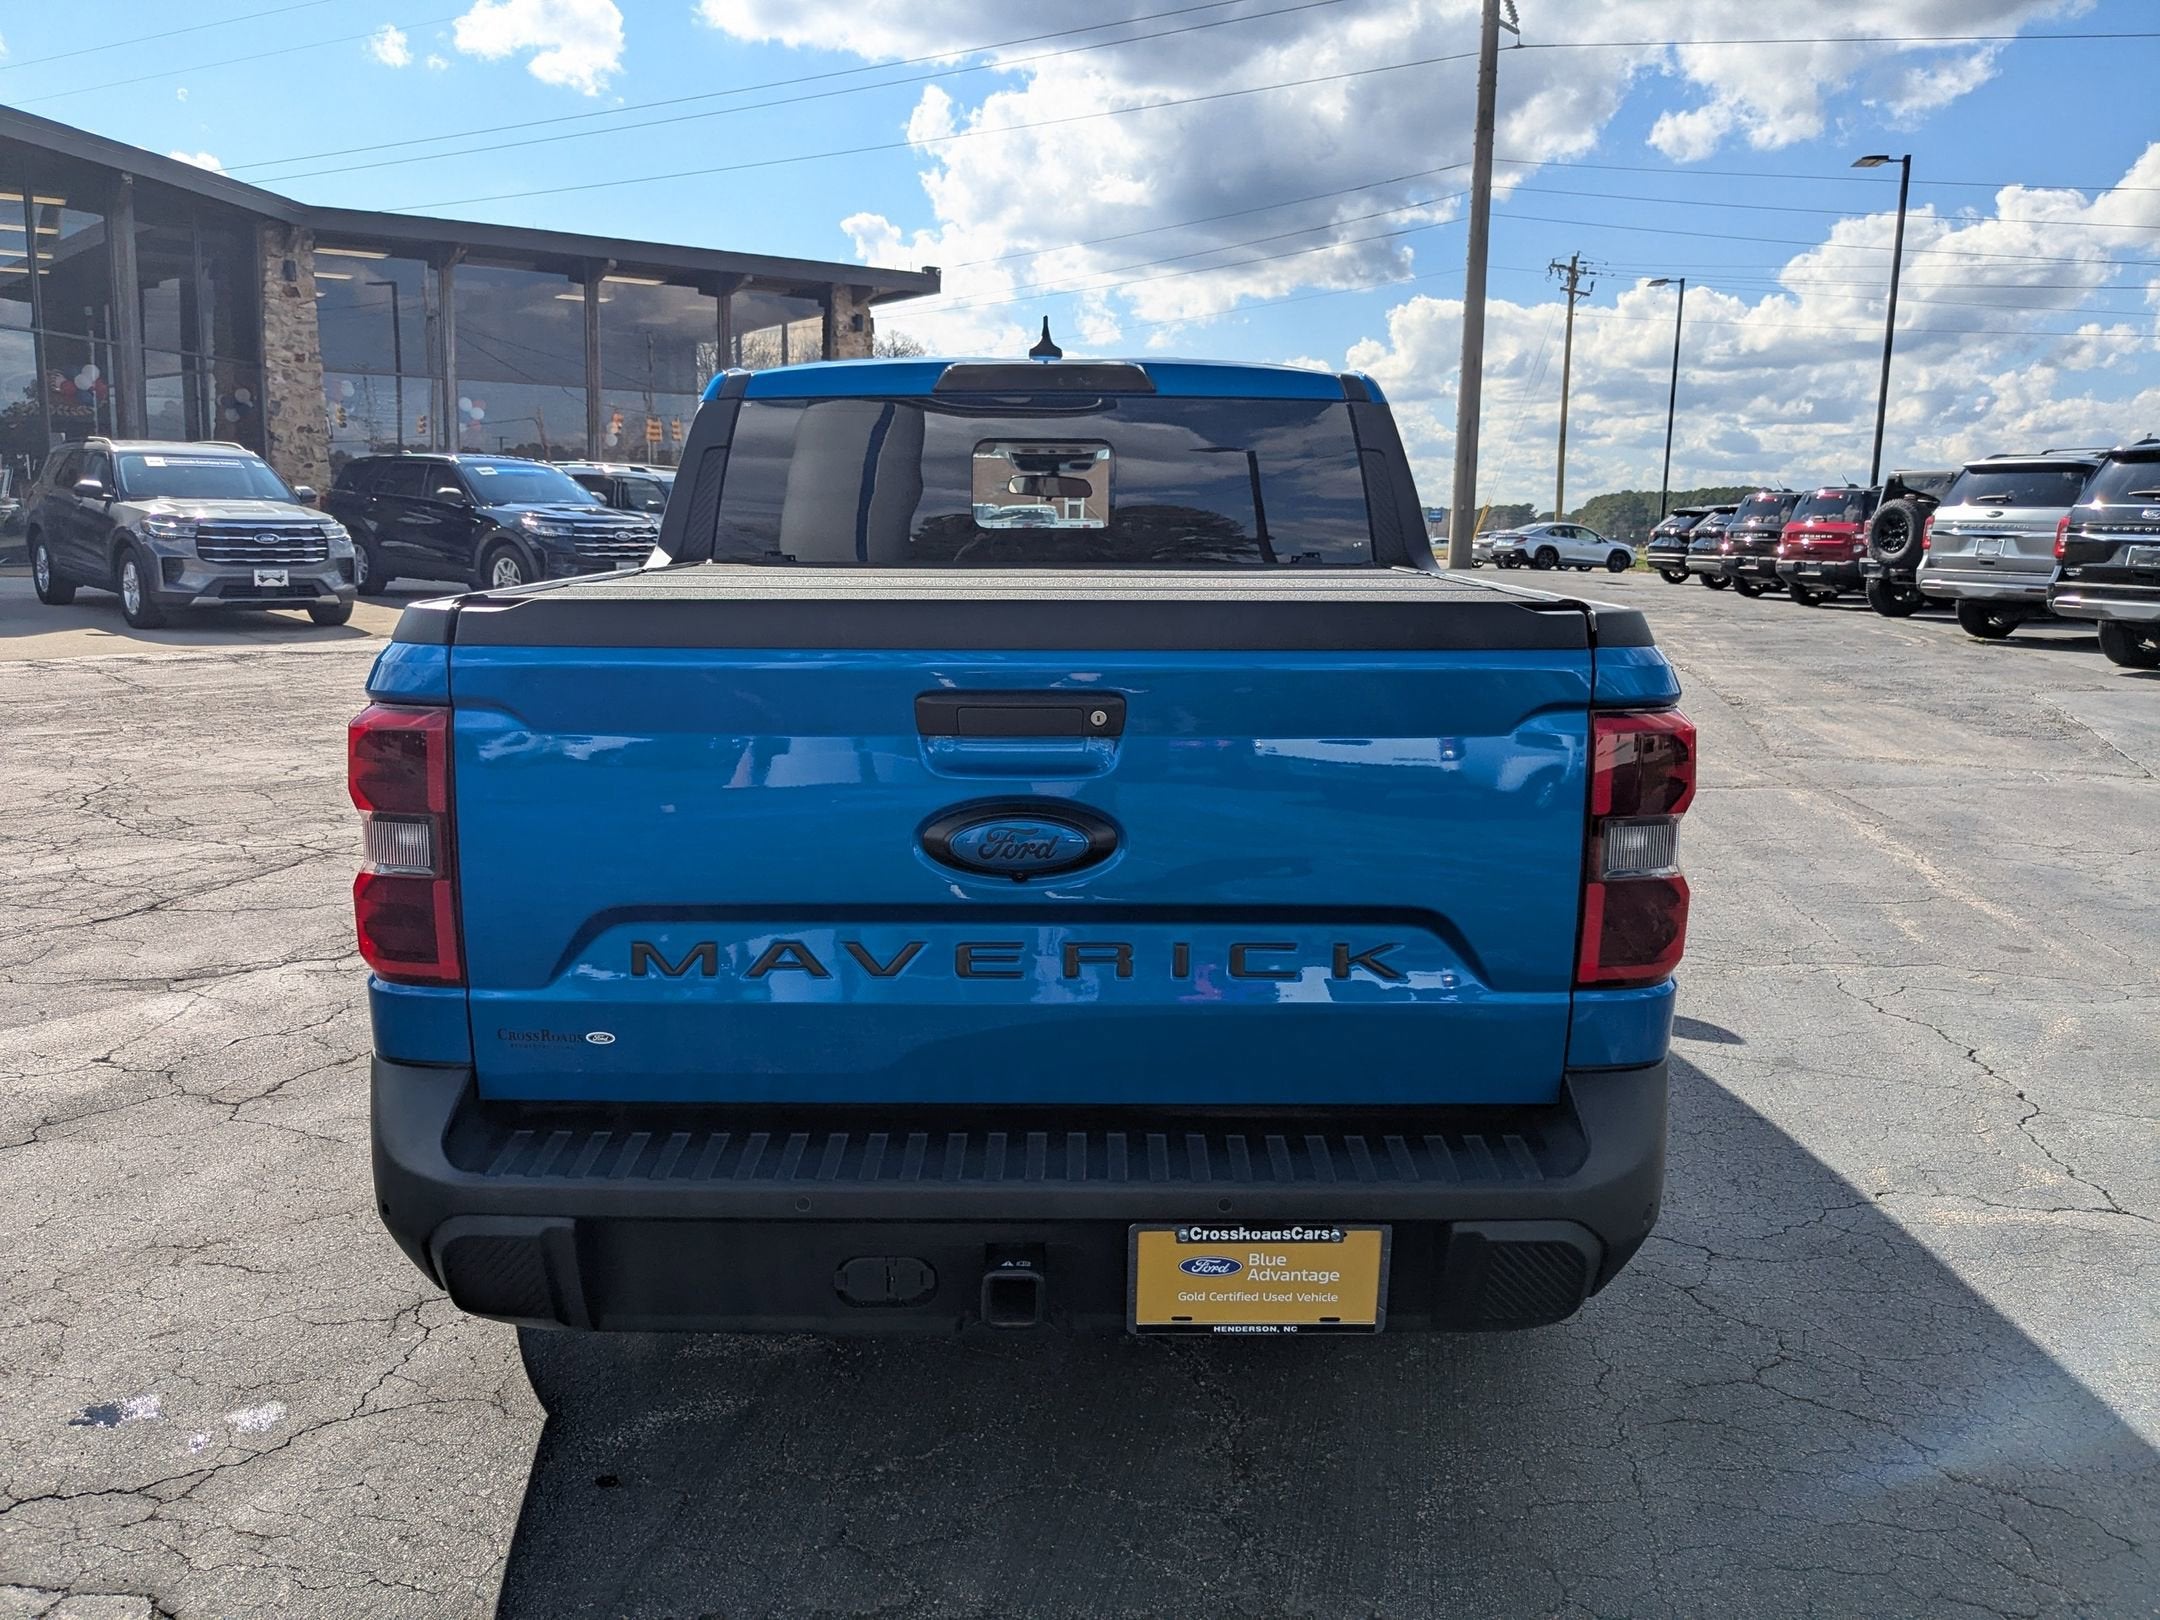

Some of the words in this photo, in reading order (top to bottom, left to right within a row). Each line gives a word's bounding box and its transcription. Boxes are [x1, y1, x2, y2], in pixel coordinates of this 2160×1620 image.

[977, 826, 1060, 862] Ford
[629, 940, 1410, 982] MAVERICK
[1190, 1258, 1231, 1274] Ford
[1248, 1253, 1288, 1267] Blue
[1247, 1268, 1341, 1284] Advantage
[1177, 1291, 1206, 1302] Gold
[1209, 1291, 1260, 1302] Certified
[1262, 1291, 1293, 1302] Used
[1296, 1291, 1339, 1303] Vehicle
[1213, 1325, 1280, 1334] HENDERSON,
[1283, 1325, 1299, 1334] NC
